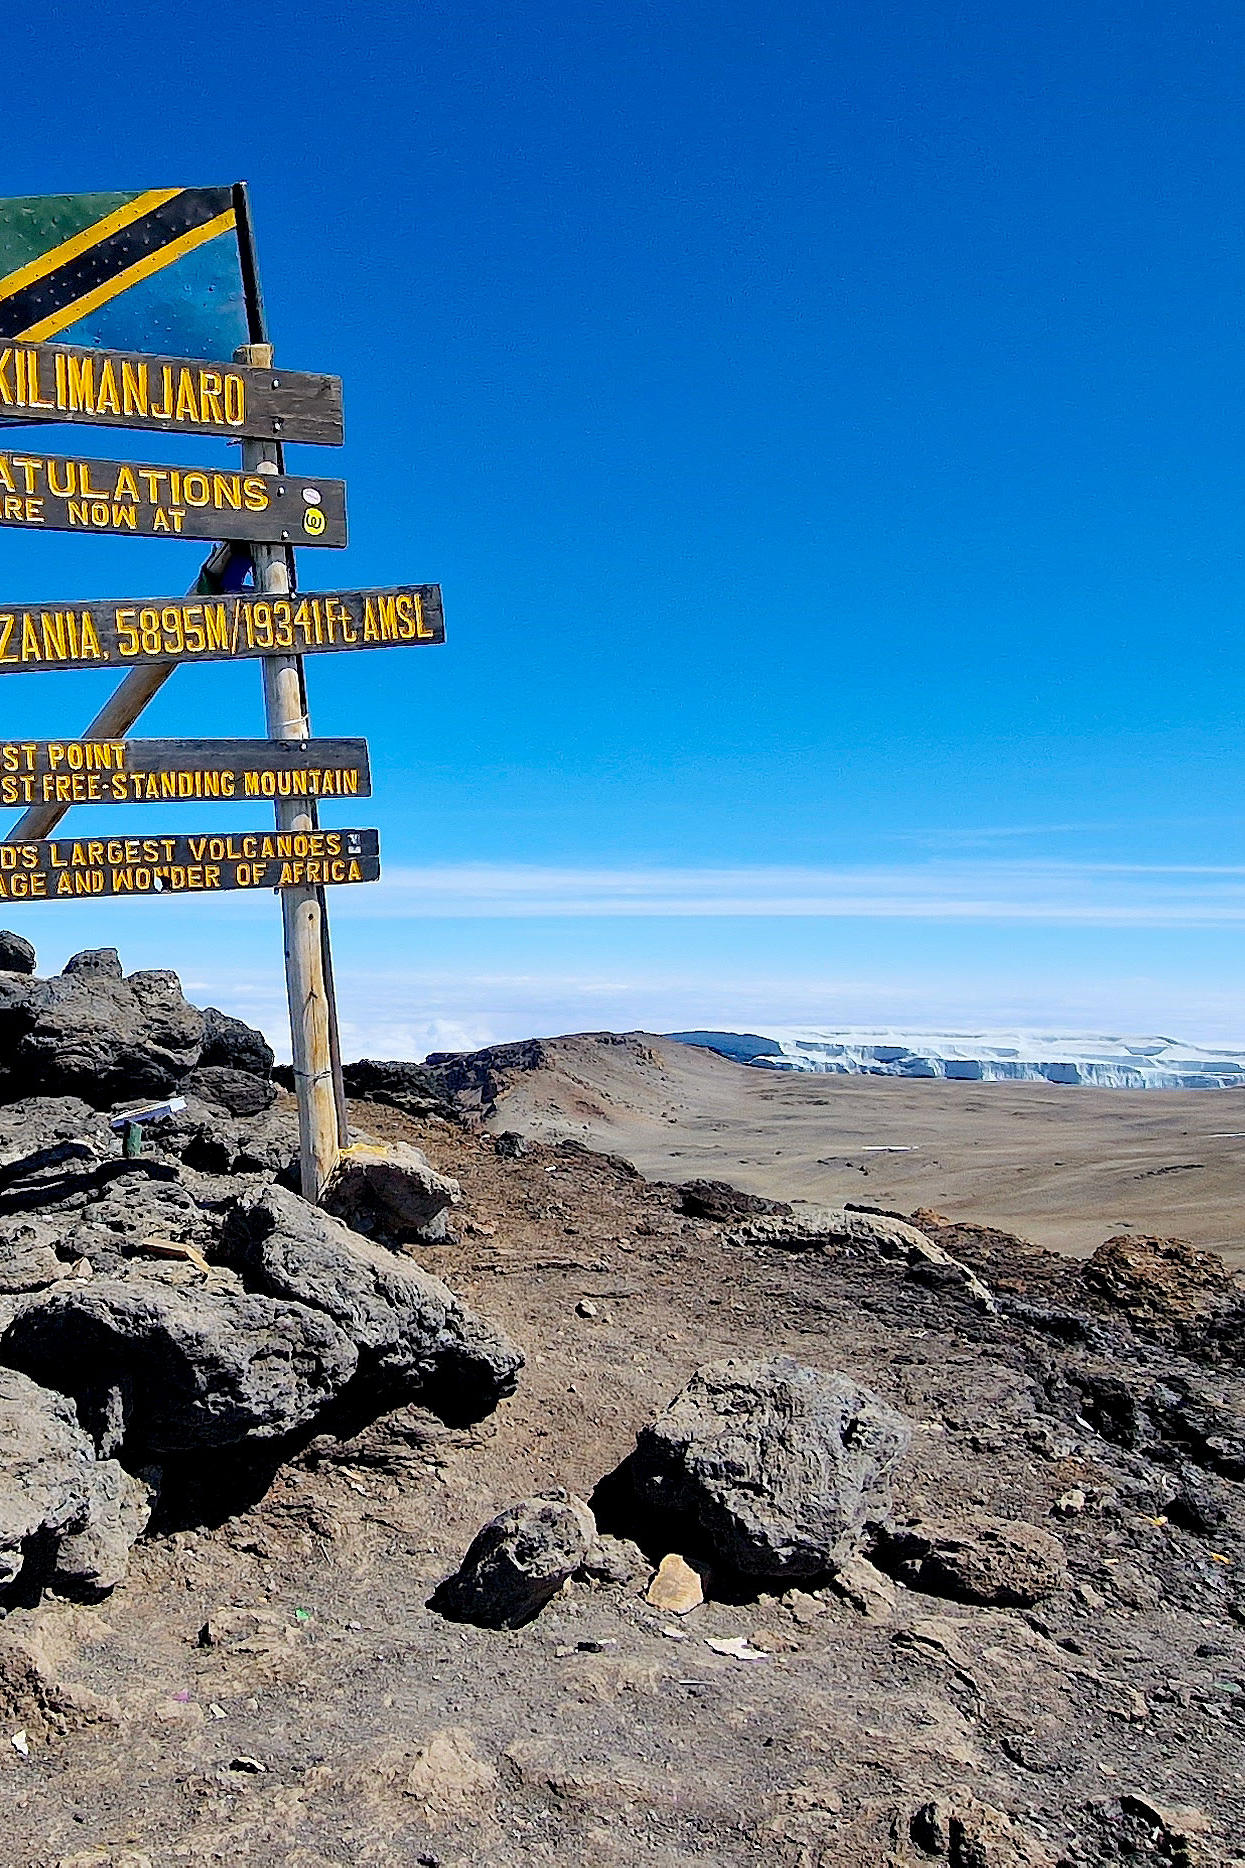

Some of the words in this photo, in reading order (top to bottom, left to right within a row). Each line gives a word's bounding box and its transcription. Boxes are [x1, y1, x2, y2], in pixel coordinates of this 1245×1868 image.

[66, 498, 138, 530] NOW
[152, 507, 186, 533] AT
[362, 594, 434, 642] AMSL
[47, 742, 126, 770] POINT
[42, 770, 236, 802] FREE-STANDING
[243, 768, 359, 798] MOUNTAIN
[50, 838, 177, 868] LARGEST
[187, 832, 342, 862] VOLCANOES
[56, 869, 105, 896] AND
[236, 861, 270, 887] OF
[280, 858, 363, 886] AFRICA
